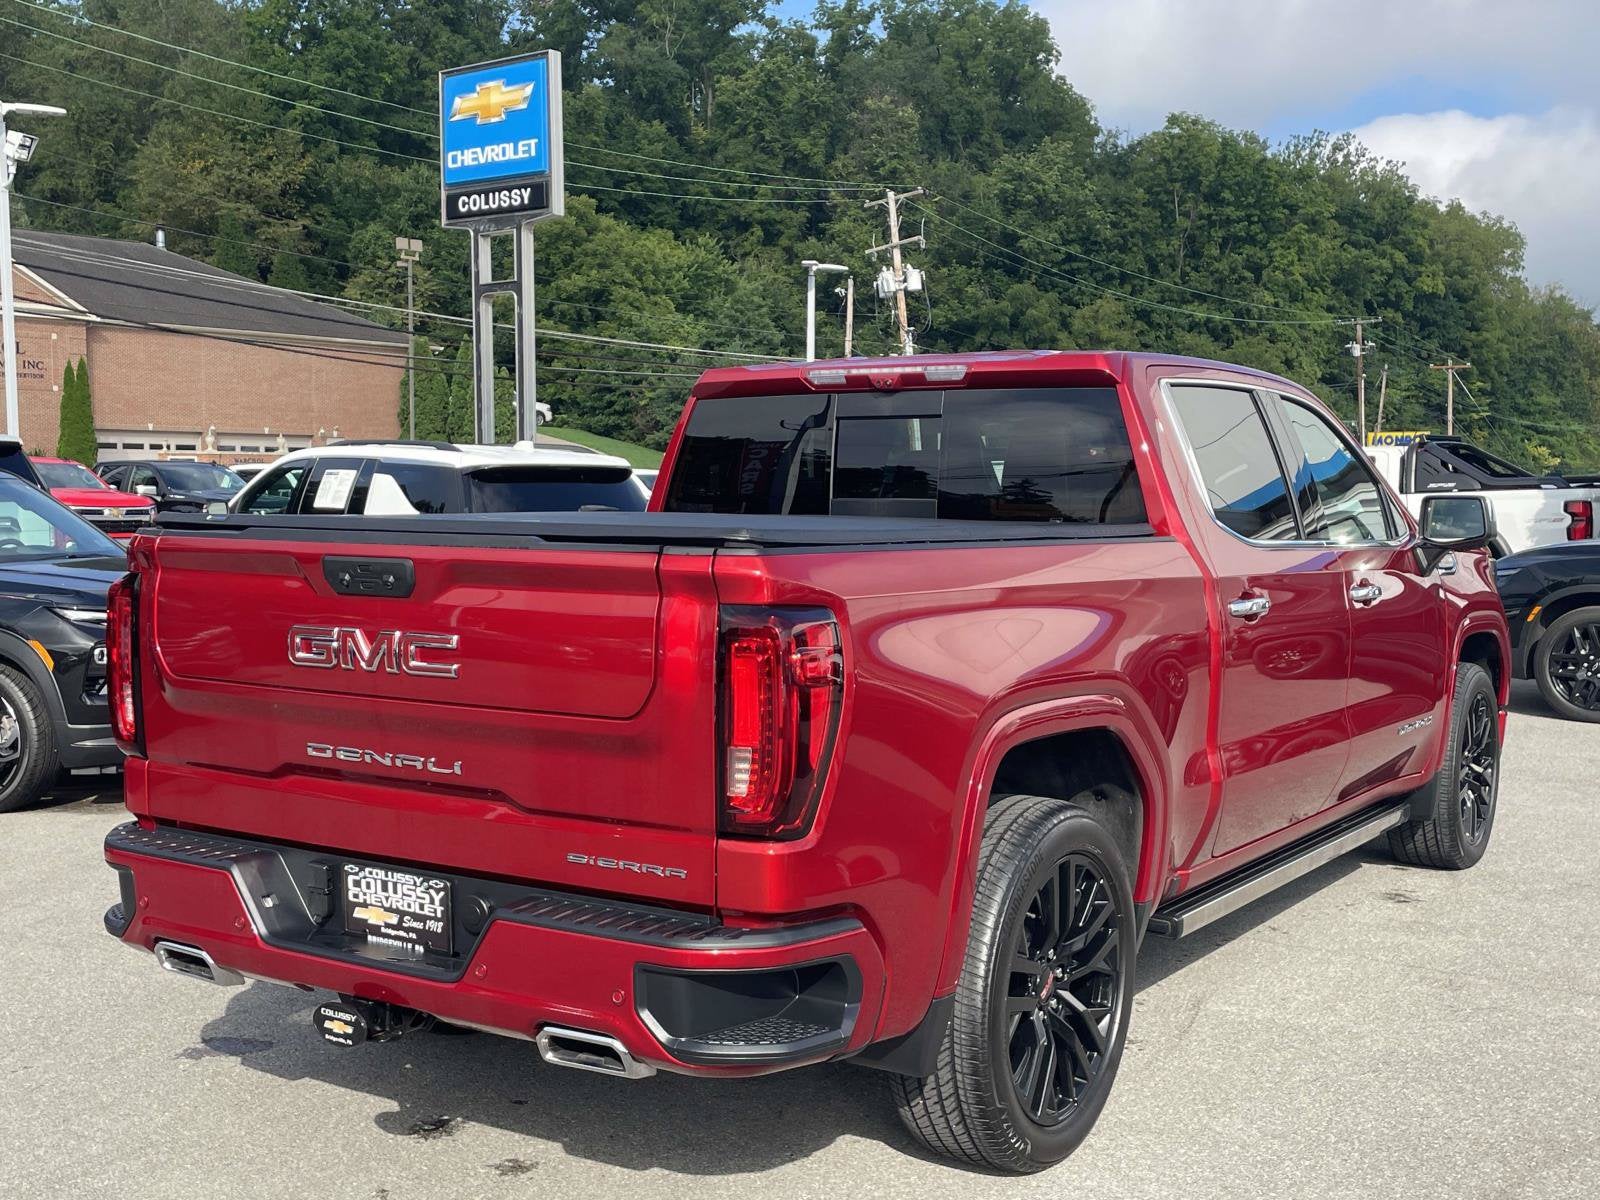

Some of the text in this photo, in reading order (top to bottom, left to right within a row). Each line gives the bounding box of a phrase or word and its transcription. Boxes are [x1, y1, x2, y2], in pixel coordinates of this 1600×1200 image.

[447, 138, 539, 168] CHEVROLET
[458, 187, 532, 212] COLUSSY
[22, 360, 48, 371] INC.
[287, 624, 462, 679] GMC
[306, 741, 463, 776] DENALI
[364, 867, 424, 886] COLUSSY
[566, 852, 688, 879] SIERRA
[347, 874, 446, 907] COLUSSY
[347, 889, 445, 918] CHEVROLET
[402, 915, 444, 934] Since 1918
[320, 1007, 358, 1022] COLUSSY
